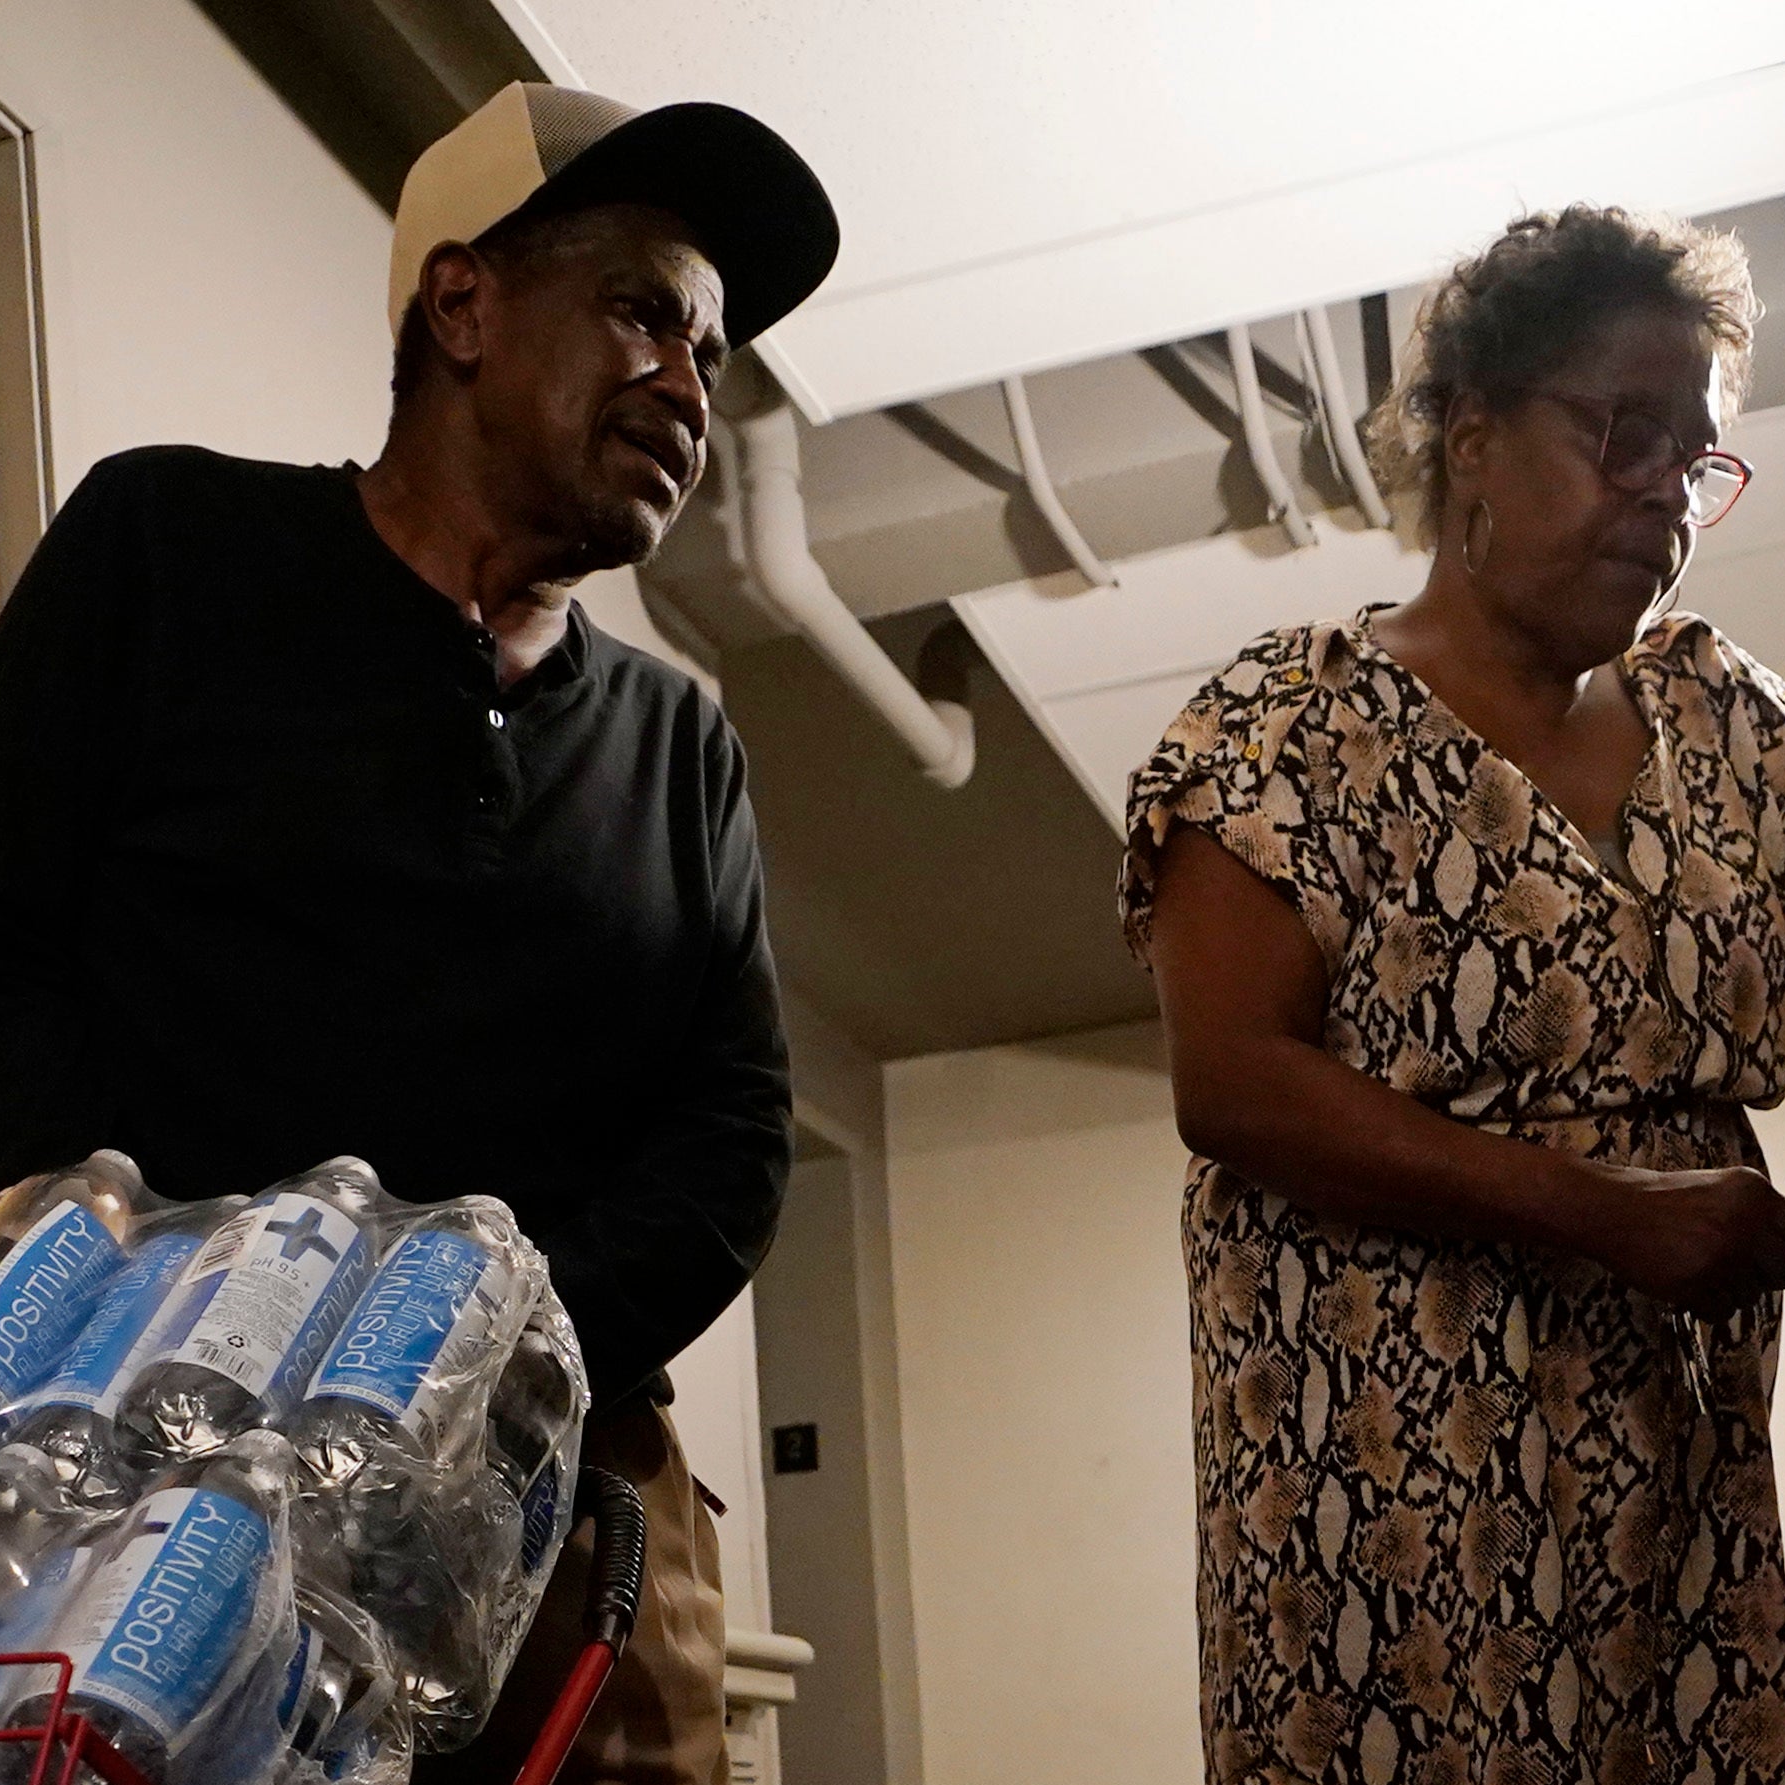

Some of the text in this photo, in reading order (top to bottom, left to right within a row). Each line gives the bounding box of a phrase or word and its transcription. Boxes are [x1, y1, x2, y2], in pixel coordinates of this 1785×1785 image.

[336, 1240, 432, 1372] POSITIVITY
[371, 1296, 432, 1370] ALKALINE
[111, 1503, 228, 1684] POSITIVITY
[208, 1518, 262, 1589] WATER
